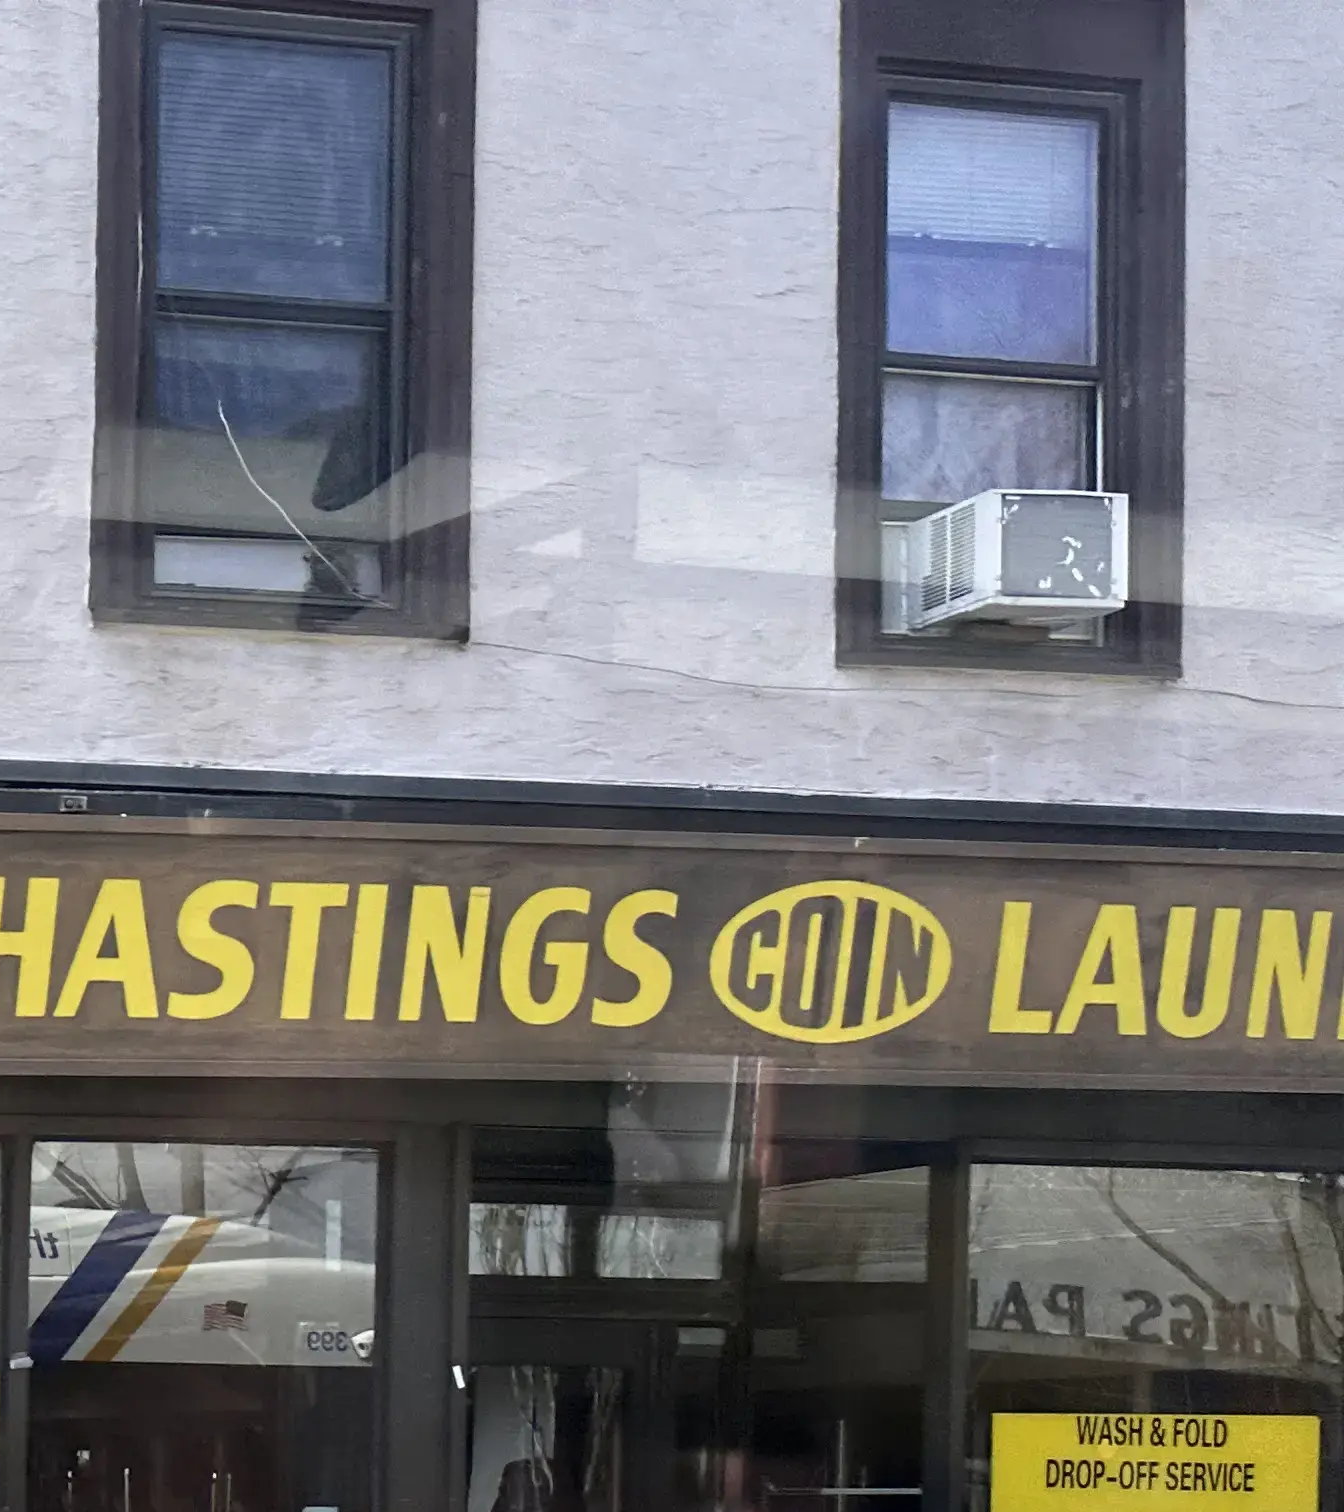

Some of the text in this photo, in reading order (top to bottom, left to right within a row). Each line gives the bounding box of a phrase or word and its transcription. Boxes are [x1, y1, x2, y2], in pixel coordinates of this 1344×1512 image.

[727, 895, 934, 1030] COIN
[987, 900, 1344, 1041] LAUN
[1077, 1416, 1228, 1448] WASH & FOLD
[1045, 1459, 1255, 1492] DROP-OFF SERVICE
